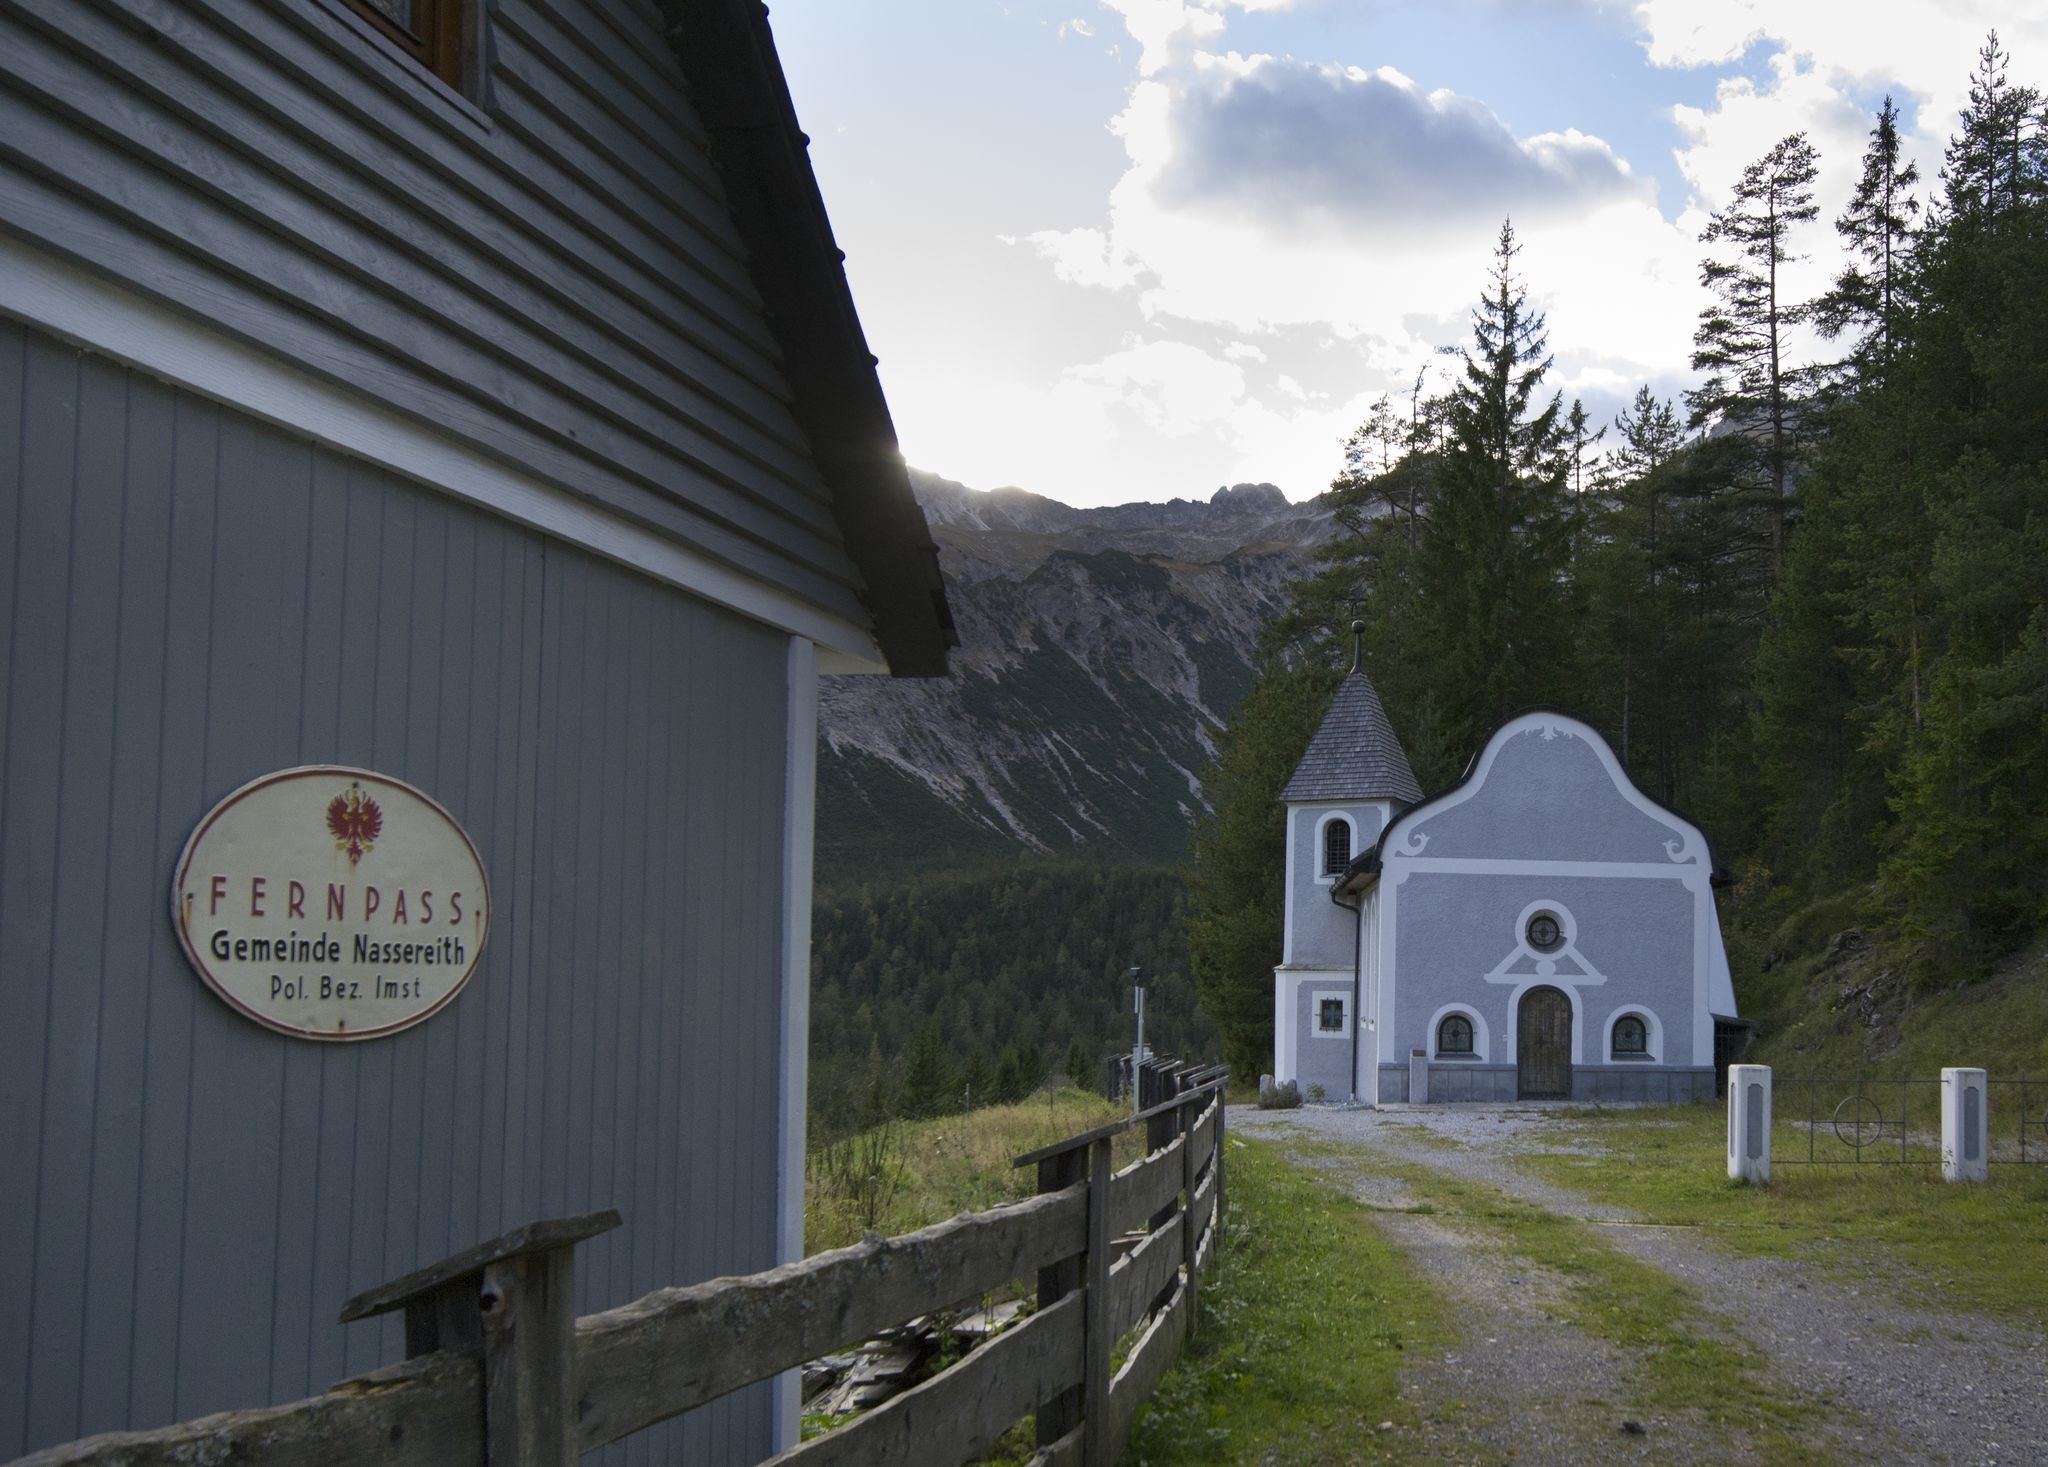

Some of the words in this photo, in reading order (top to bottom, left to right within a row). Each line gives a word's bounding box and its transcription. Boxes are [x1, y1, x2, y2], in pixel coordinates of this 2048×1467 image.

[210, 876, 463, 925] FERNPASS
[211, 930, 341, 962] Gemeinde
[353, 933, 464, 965] Nassereith
[271, 975, 308, 1000] Pol.
[320, 975, 363, 1000] Bez.
[376, 975, 421, 999] Imst
